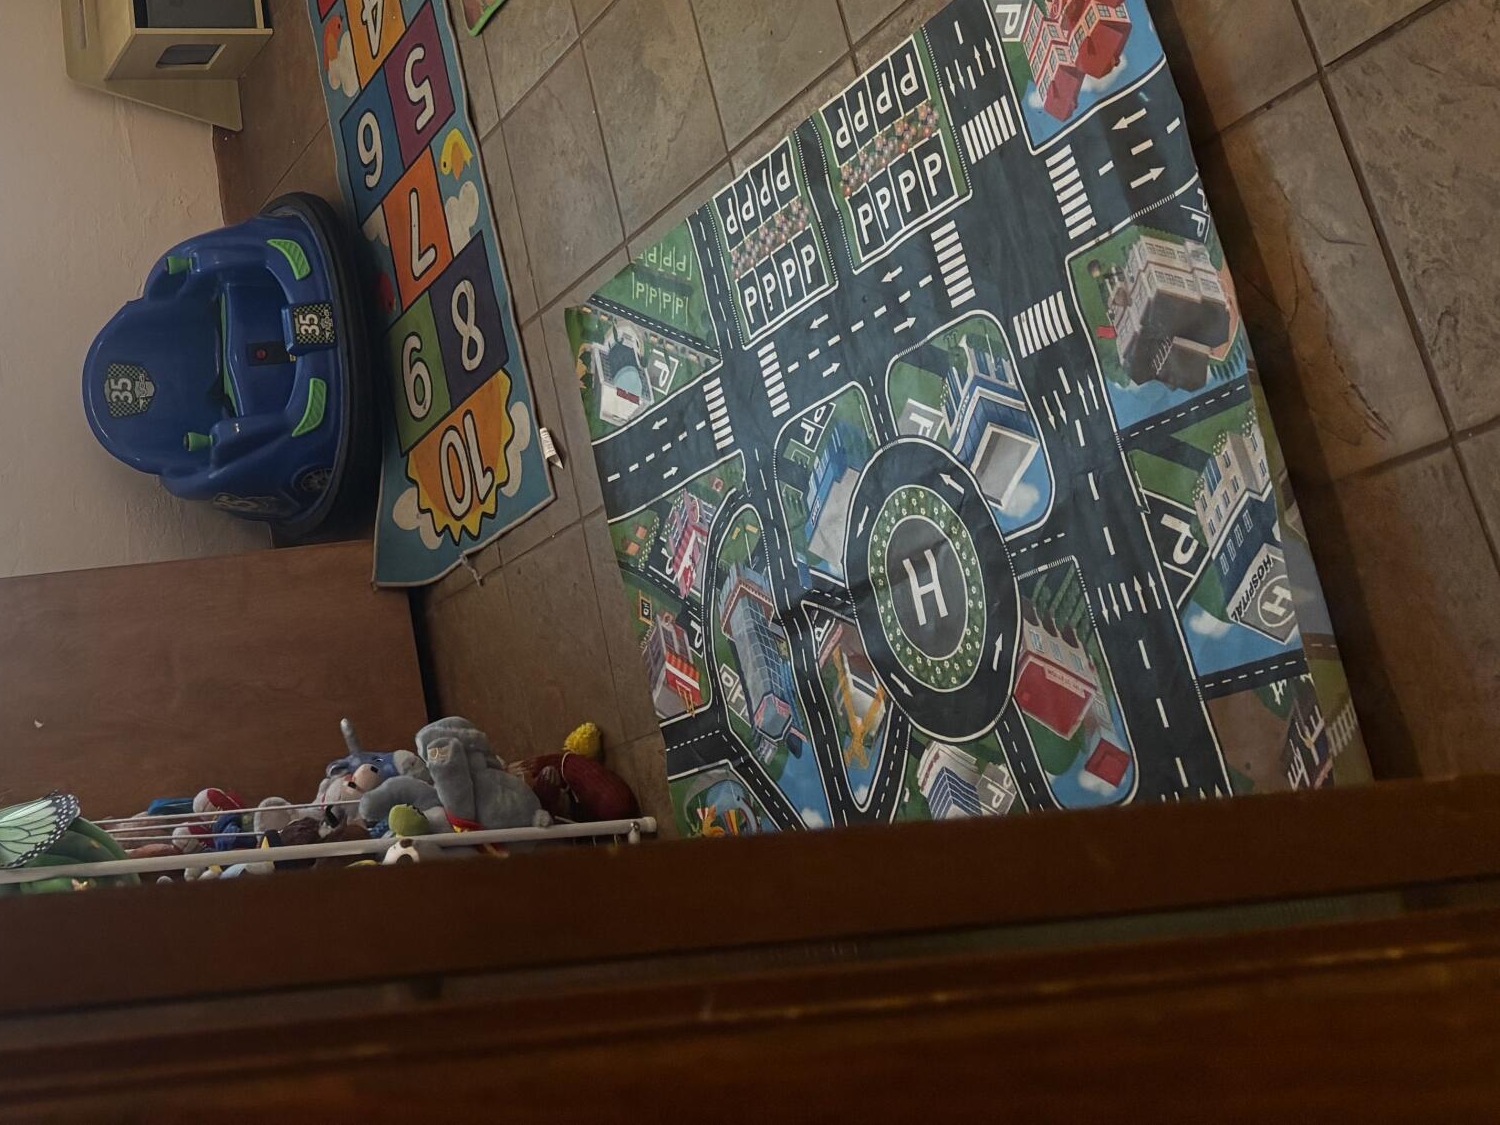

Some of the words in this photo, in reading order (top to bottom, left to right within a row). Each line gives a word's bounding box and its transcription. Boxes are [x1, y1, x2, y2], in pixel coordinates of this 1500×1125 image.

[403, 43, 436, 132] 5
[408, 187, 438, 281] 7
[298, 313, 320, 336] 35
[451, 279, 485, 373] 8
[110, 377, 133, 404] 35
[439, 409, 495, 521] 10
[902, 549, 949, 626] H
[1231, 553, 1272, 622] HOSPITAL
[1261, 585, 1293, 617] H
